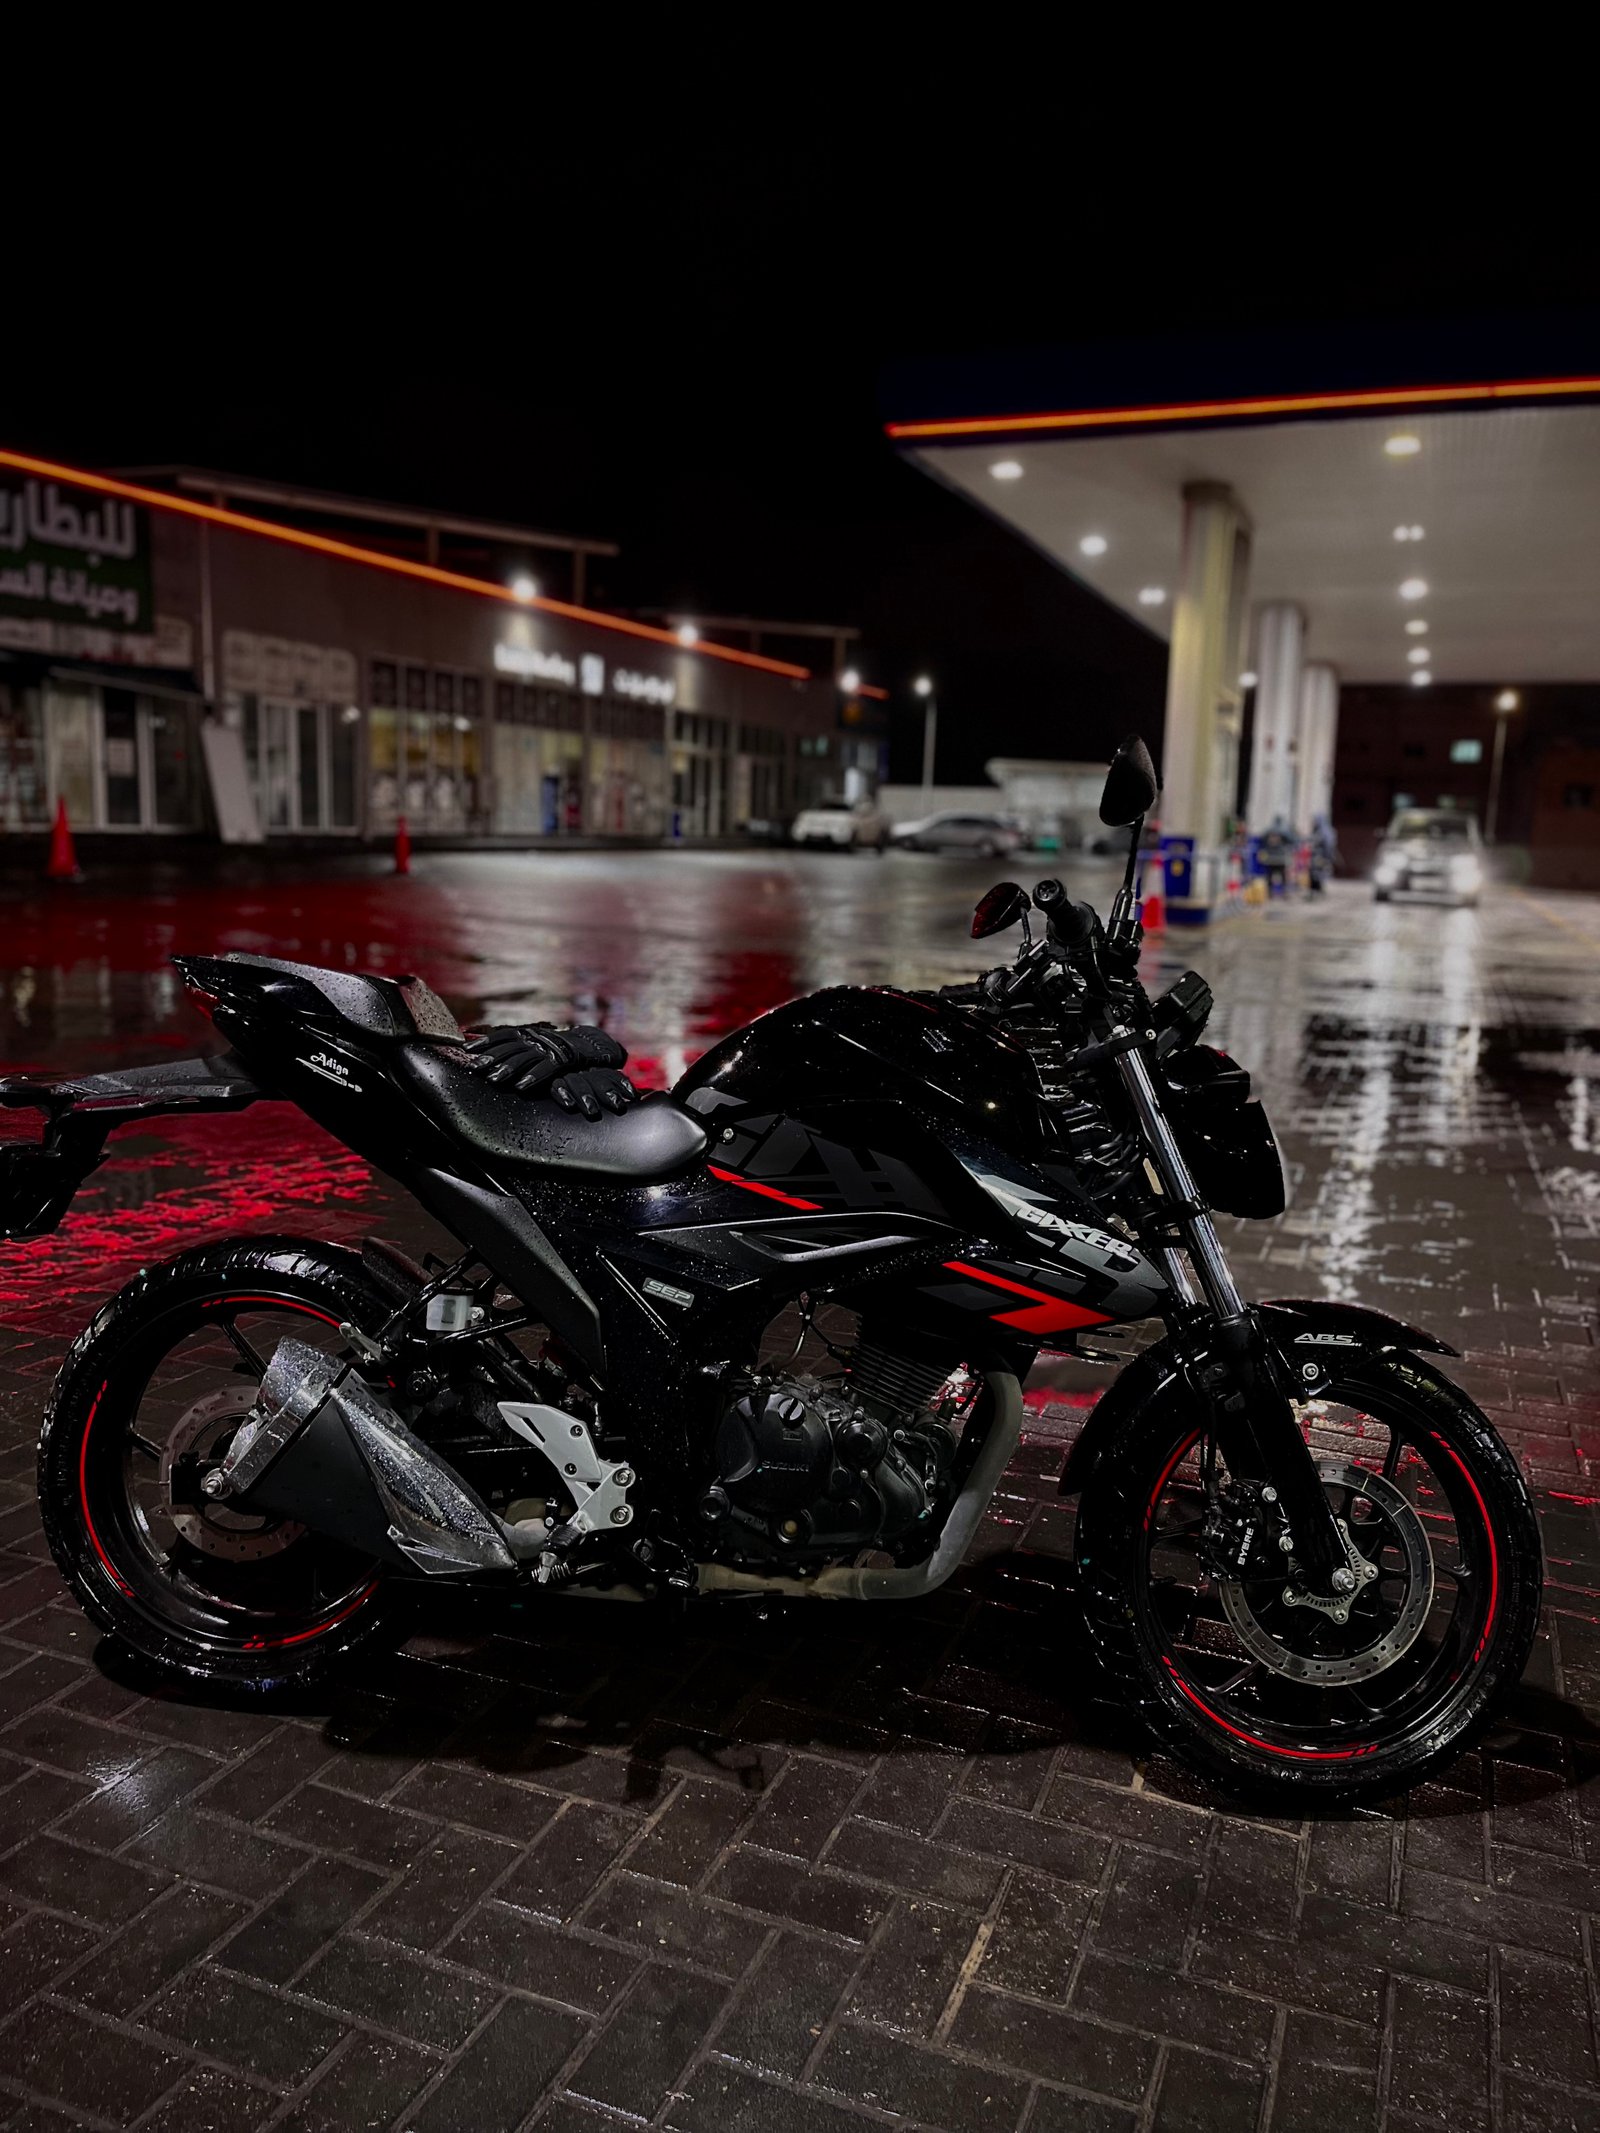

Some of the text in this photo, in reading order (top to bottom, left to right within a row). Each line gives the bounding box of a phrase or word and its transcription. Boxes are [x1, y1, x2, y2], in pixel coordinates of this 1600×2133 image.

[646, 1280, 691, 1300] SEP
[1294, 1332, 1354, 1345] ABS
[761, 1459, 810, 1473] SUZUKI
